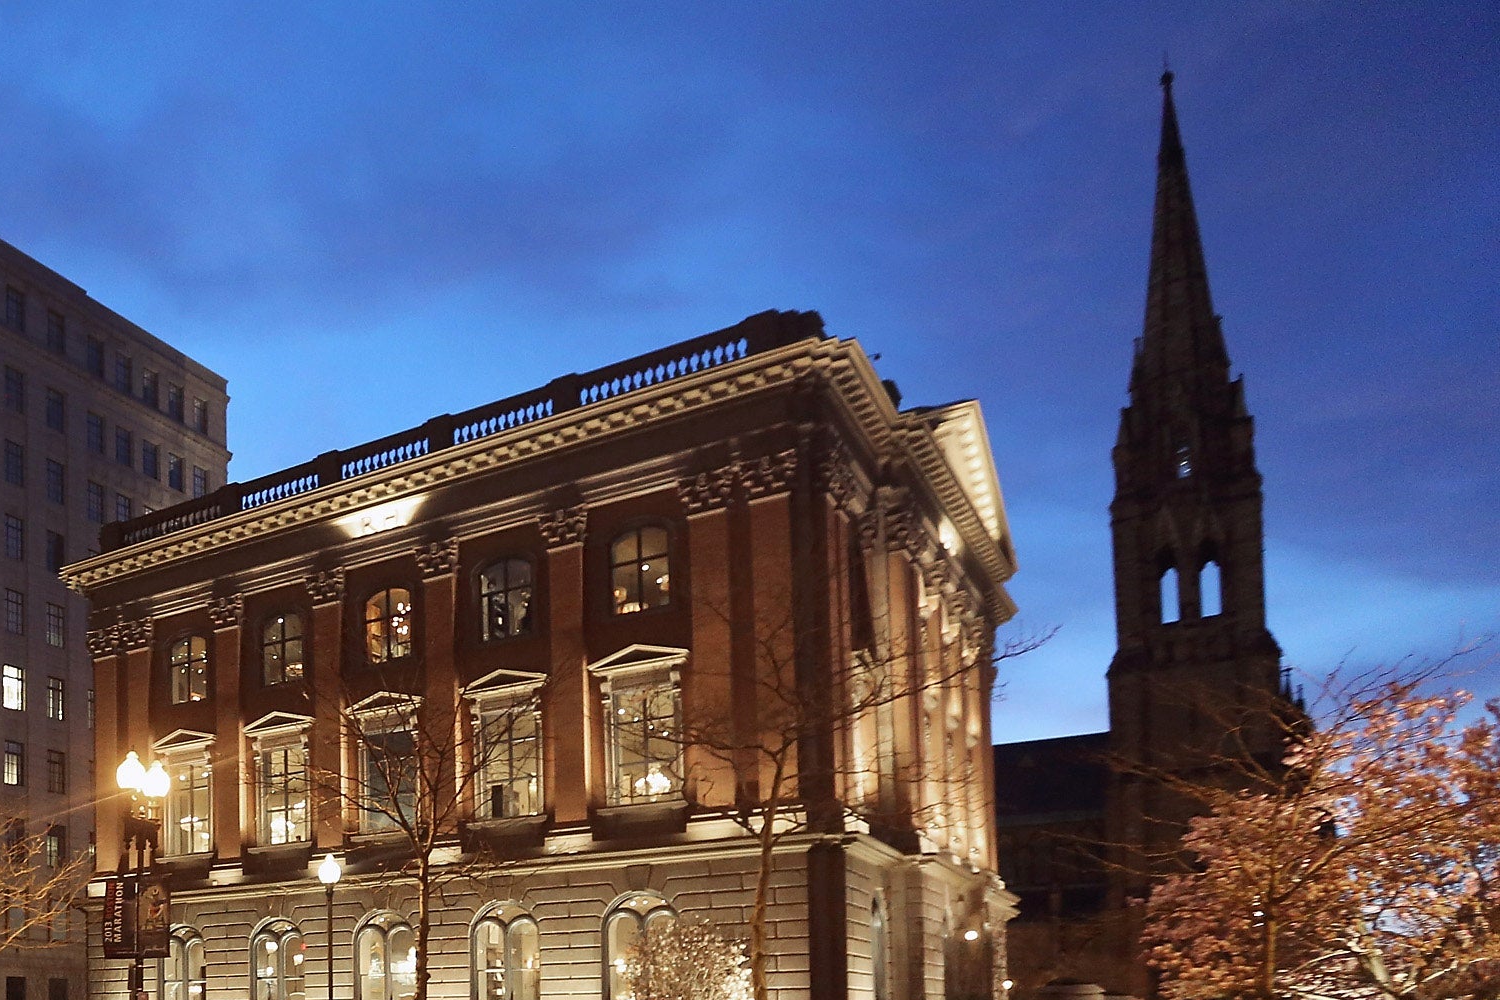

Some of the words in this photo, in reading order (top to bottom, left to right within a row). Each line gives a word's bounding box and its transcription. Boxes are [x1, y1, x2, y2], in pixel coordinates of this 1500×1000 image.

[106, 882, 115, 918] BOSTON
[113, 882, 124, 943] MARATHON
[104, 921, 113, 942] 2013
